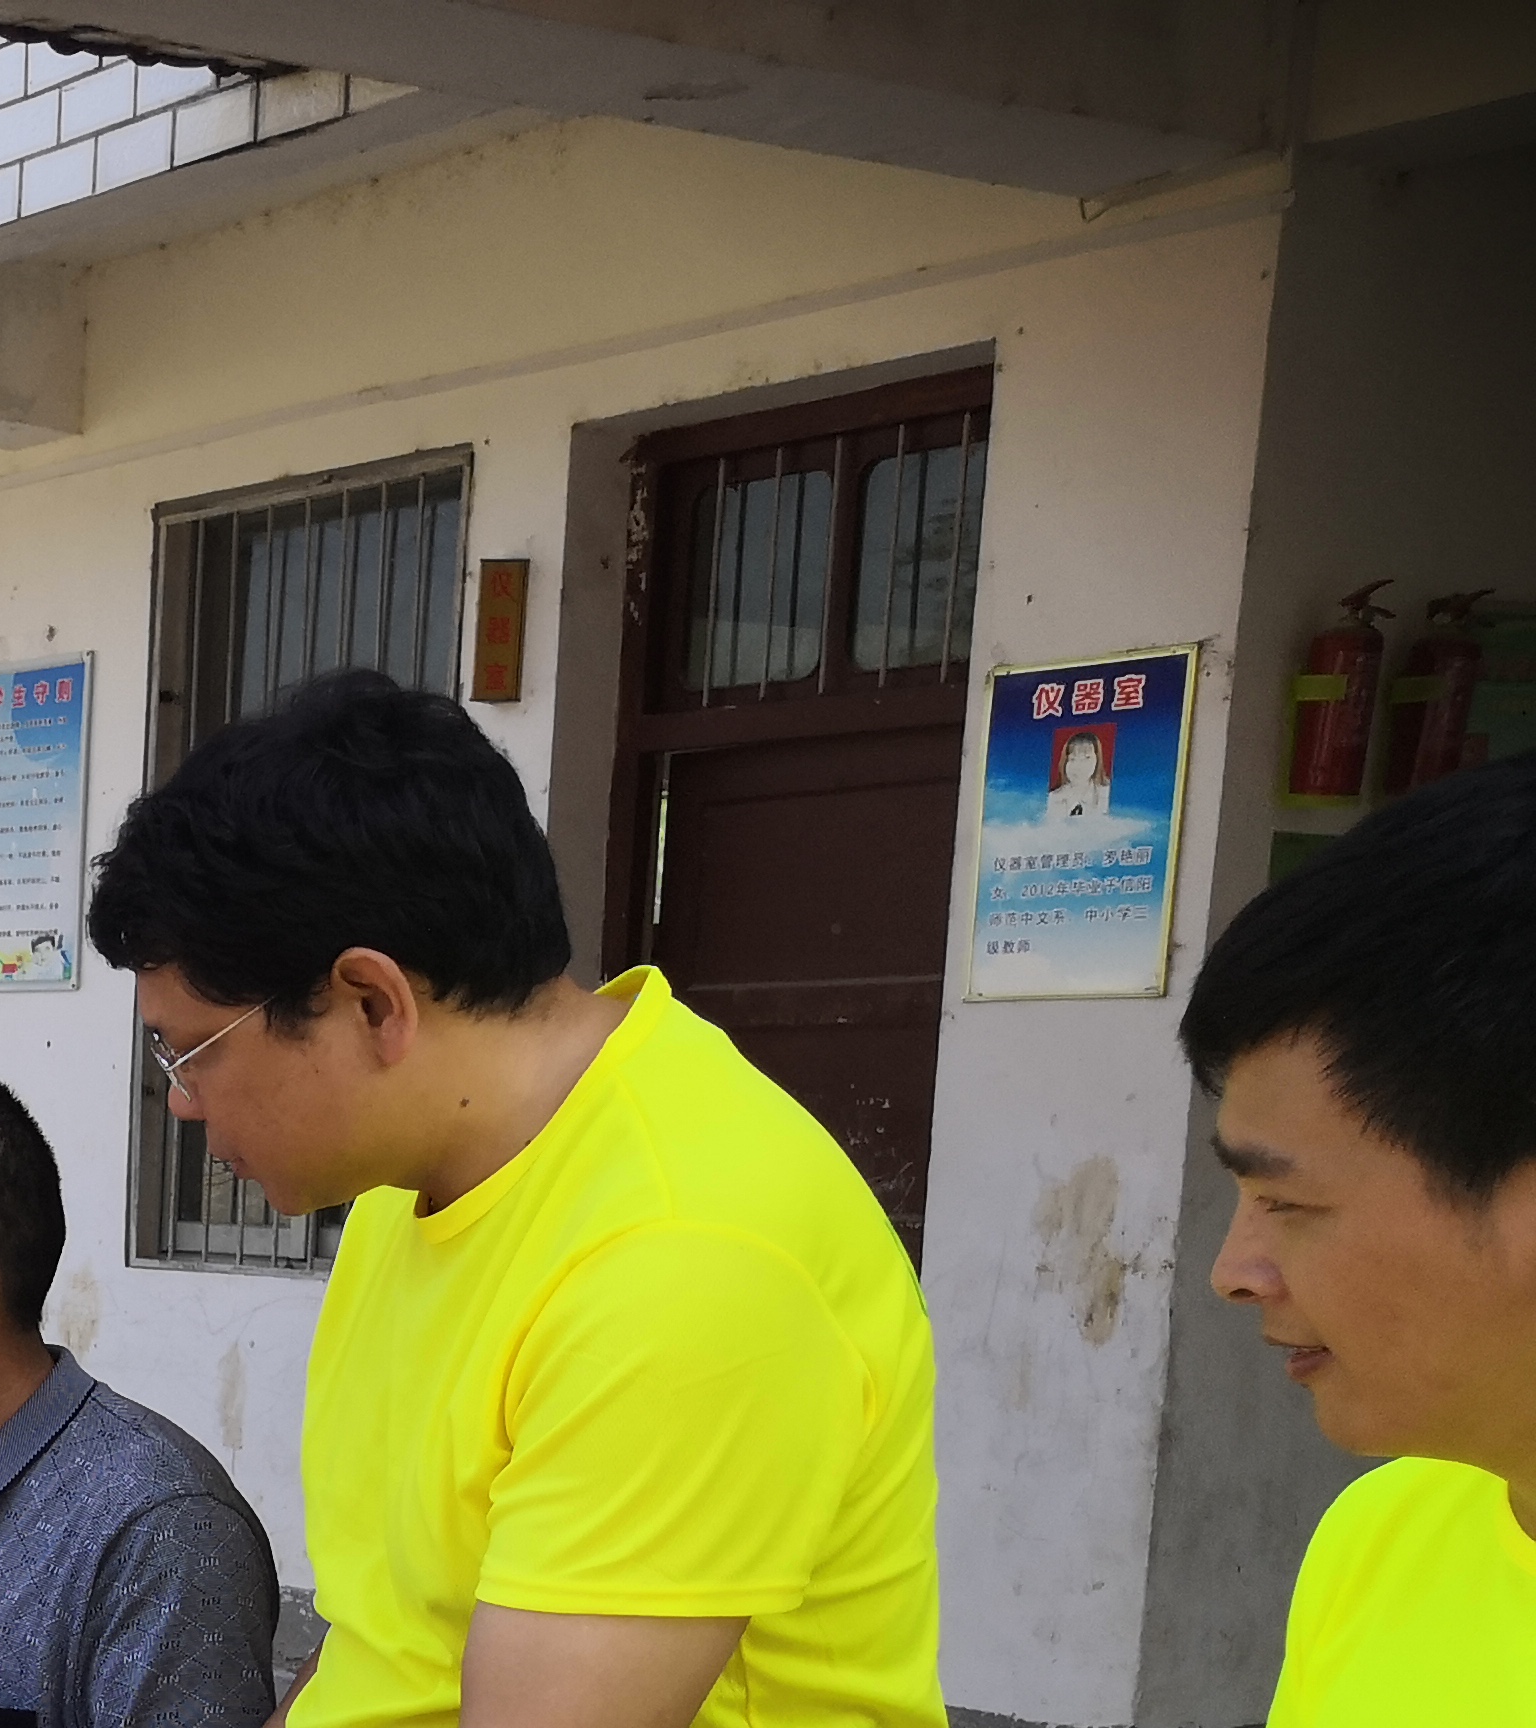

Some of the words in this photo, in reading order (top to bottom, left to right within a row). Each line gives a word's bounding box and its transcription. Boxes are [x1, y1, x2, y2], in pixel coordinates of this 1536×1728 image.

[484, 570, 513, 691] 仪器室
[1033, 676, 1145, 718] 仪器室
